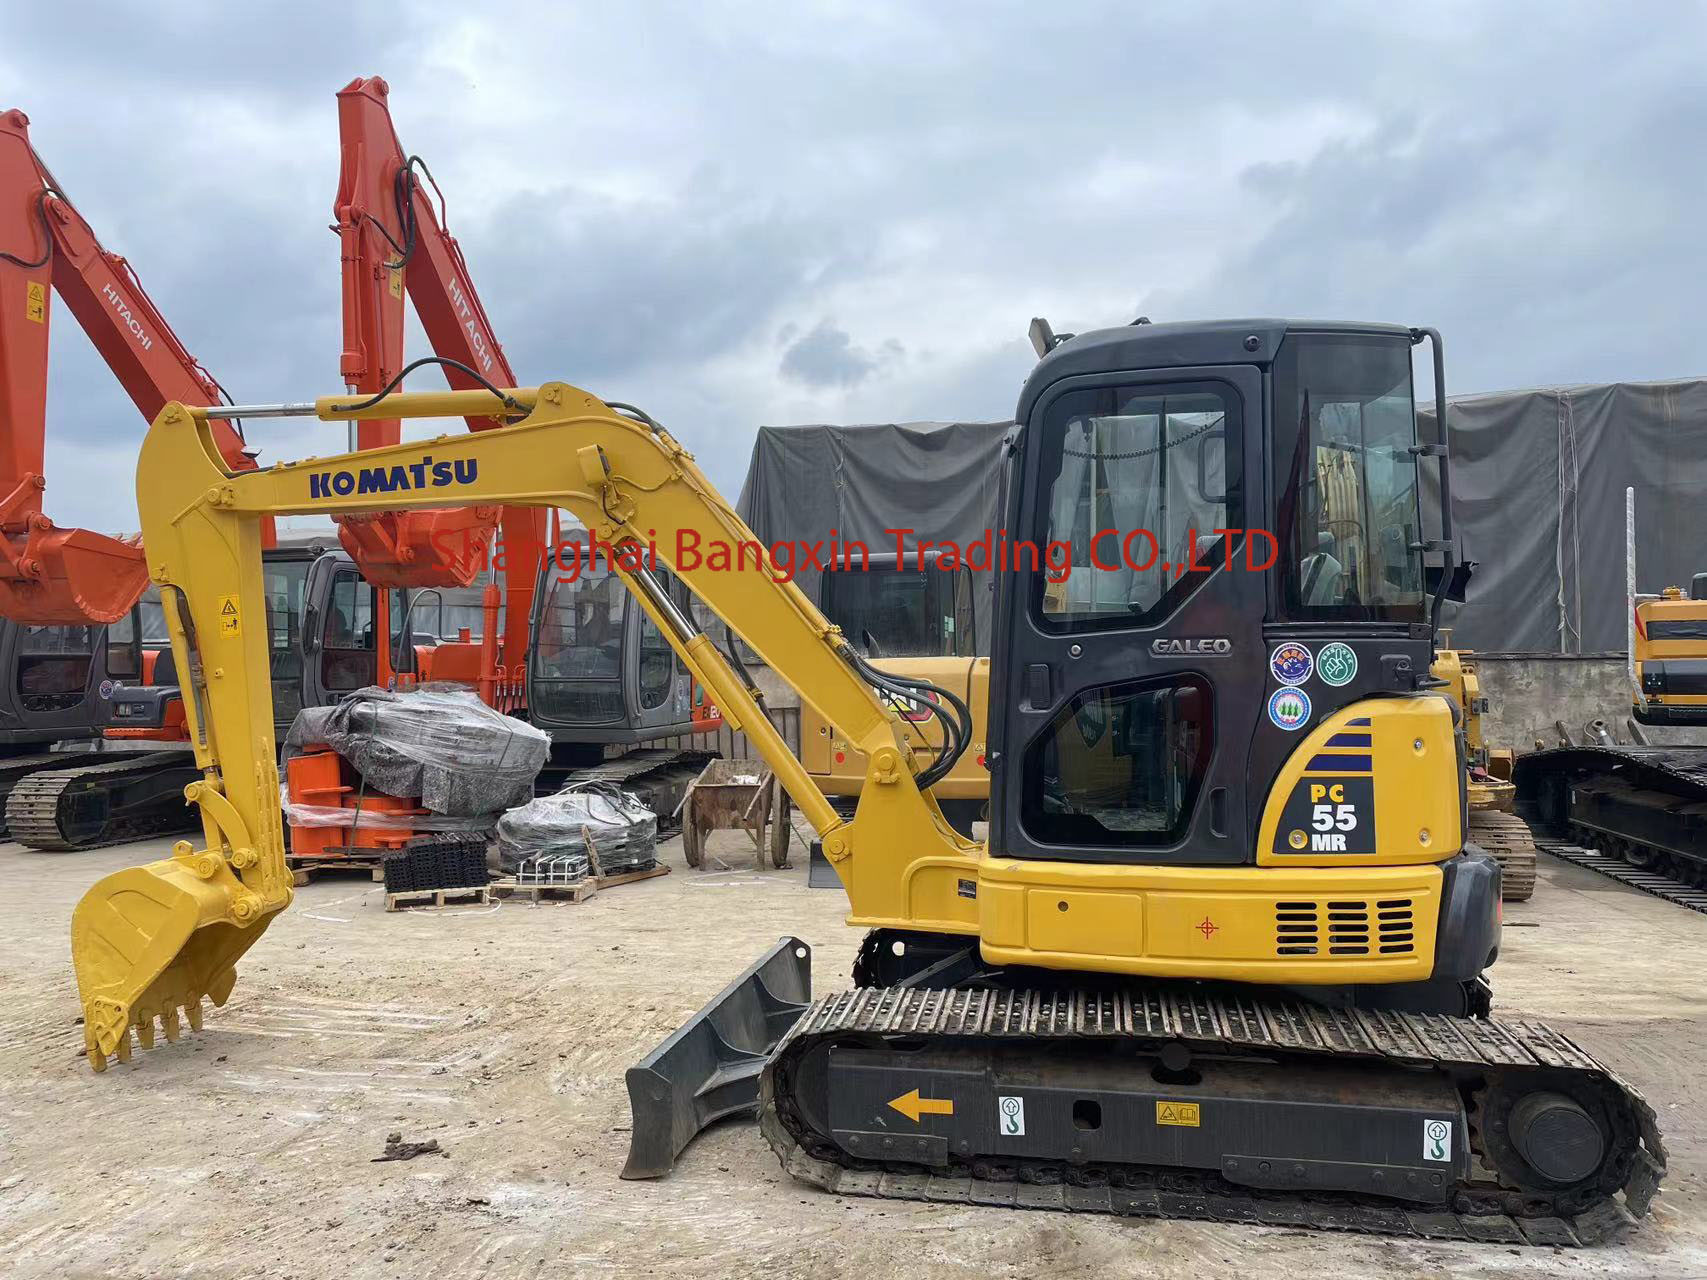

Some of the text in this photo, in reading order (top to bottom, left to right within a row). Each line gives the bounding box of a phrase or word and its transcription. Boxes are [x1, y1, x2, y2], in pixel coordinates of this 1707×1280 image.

[102, 282, 152, 350] HITACHI
[448, 277, 492, 372] HITACHI
[309, 456, 478, 499] KOMATSU
[1152, 638, 1231, 654] GALEO
[1311, 784, 1344, 803] PC
[1312, 804, 1358, 831] 55
[1312, 833, 1347, 852] MR
